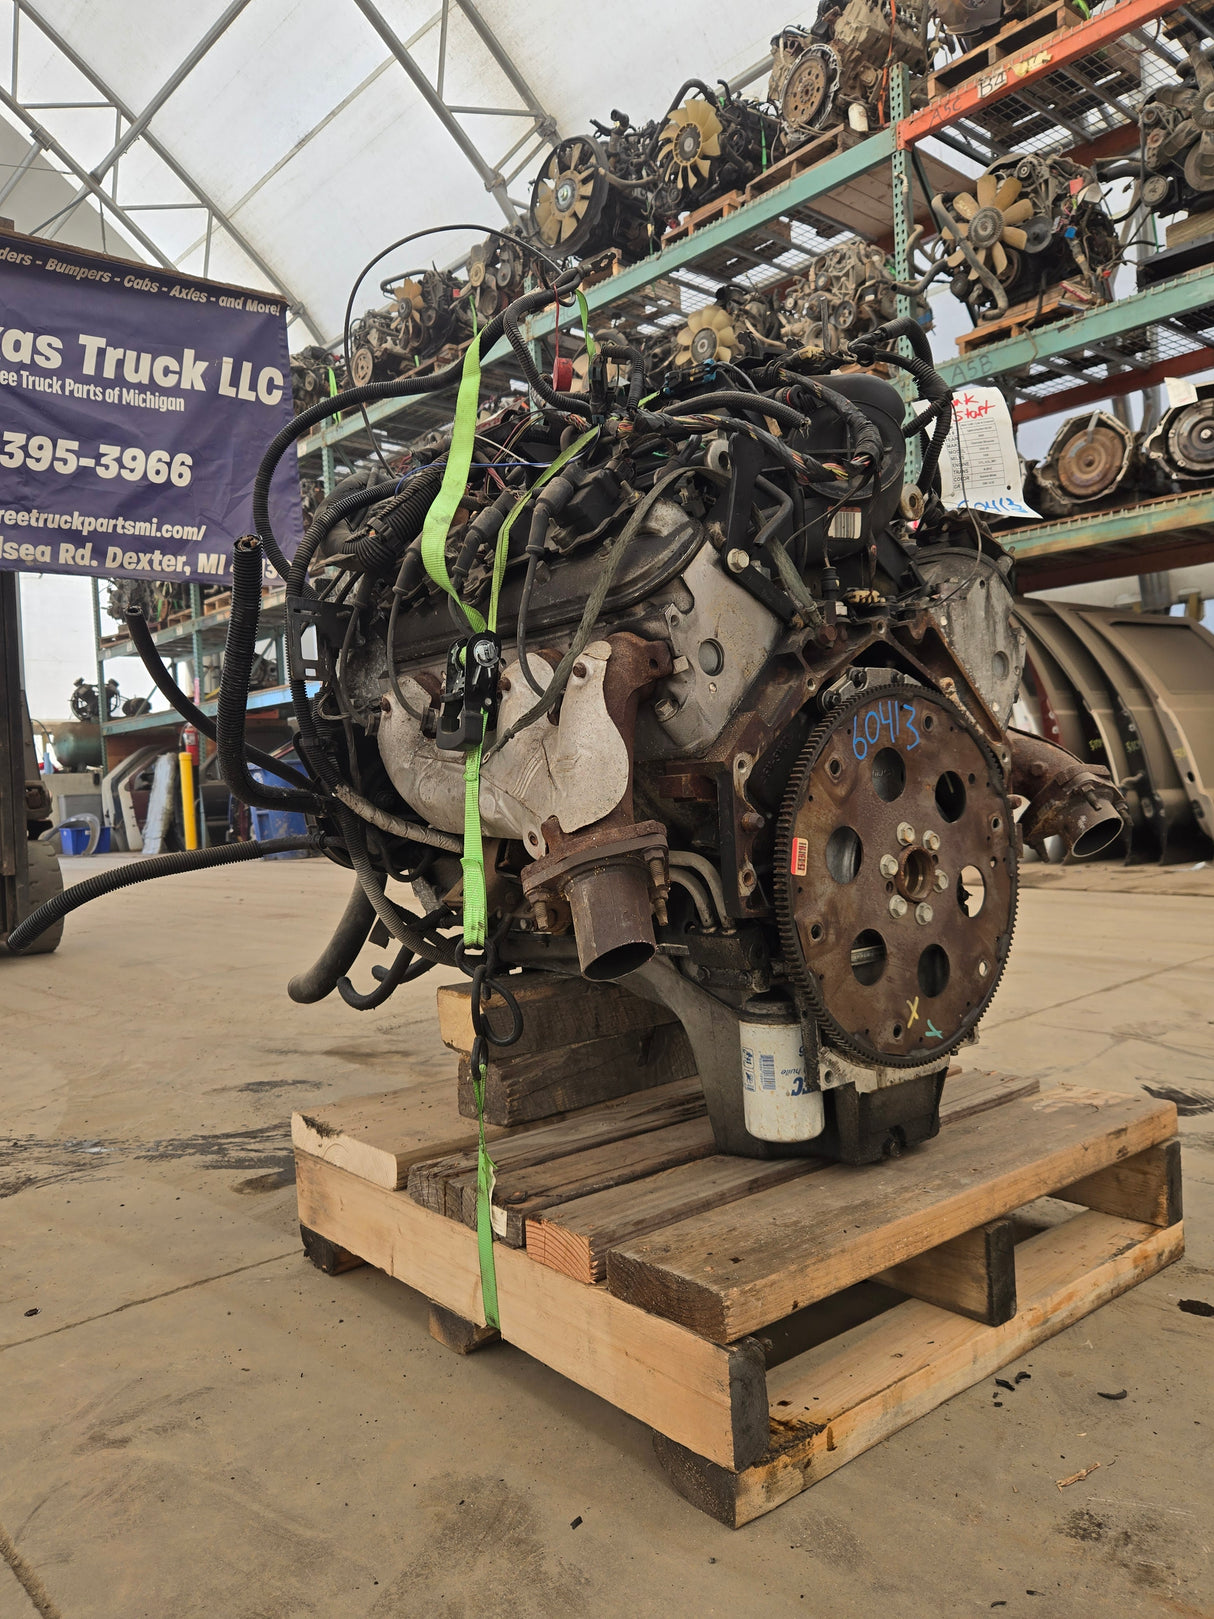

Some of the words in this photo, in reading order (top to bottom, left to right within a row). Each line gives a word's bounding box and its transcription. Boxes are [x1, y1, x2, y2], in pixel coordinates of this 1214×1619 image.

[0, 247, 33, 265] ders
[45, 258, 112, 282] Bumpers
[123, 275, 160, 293] Cabs
[169, 285, 208, 303] Axles
[219, 295, 244, 310] and
[245, 300, 281, 316] More!
[0, 326, 63, 369] as
[78, 333, 209, 392] Truck
[218, 356, 284, 406] LLC
[20, 370, 63, 395] Truck
[65, 378, 103, 401] Parts
[105, 386, 120, 404] of
[122, 387, 185, 412] Michigan
[951, 354, 993, 384] A5B
[0, 431, 193, 487] 395-3966
[58, 542, 98, 567] Rd.
[105, 546, 191, 576] Dexter,
[197, 552, 227, 575] MI
[853, 700, 921, 760] 60413
